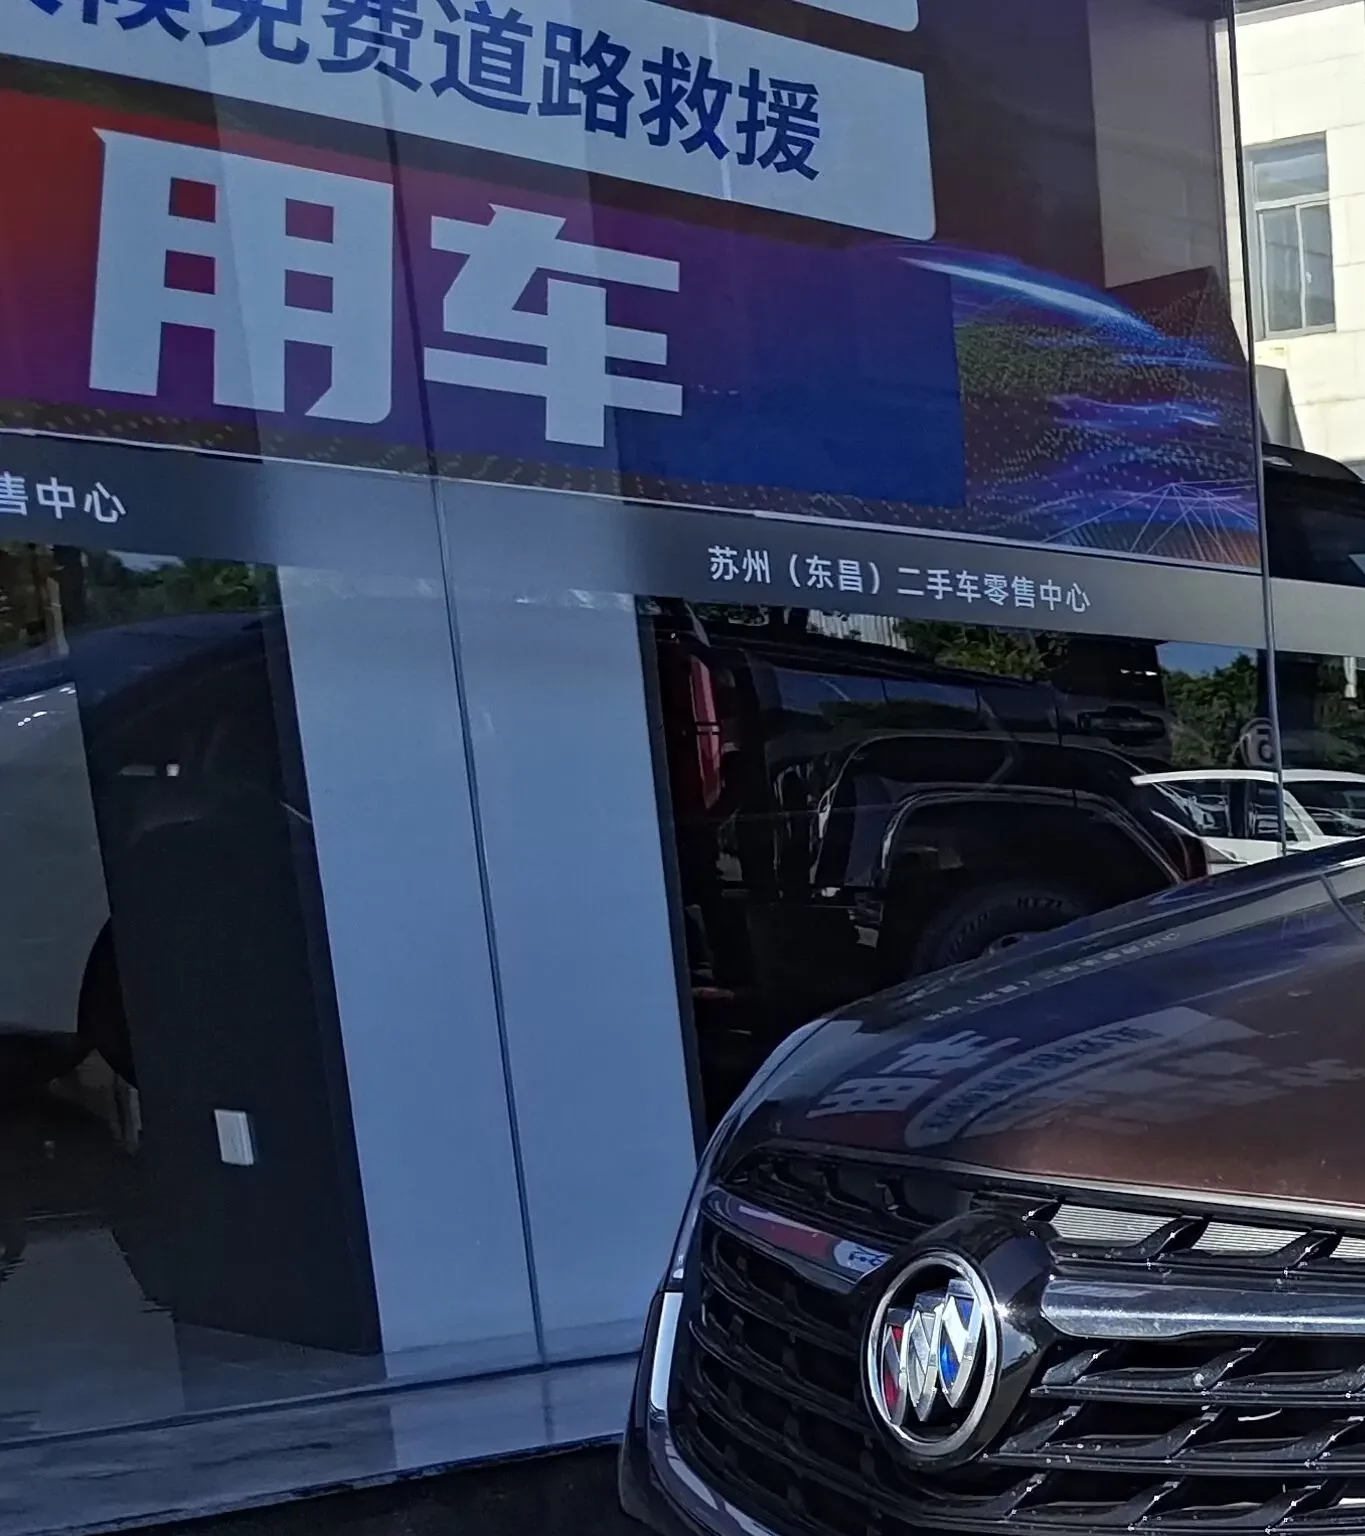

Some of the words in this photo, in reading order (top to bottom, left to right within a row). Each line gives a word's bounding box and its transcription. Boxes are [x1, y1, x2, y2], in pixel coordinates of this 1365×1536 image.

[89, 127, 684, 448] 用车
[0, 471, 127, 524] 售中心
[708, 545, 1091, 613] 苏州（东昌）二手车零售中心
